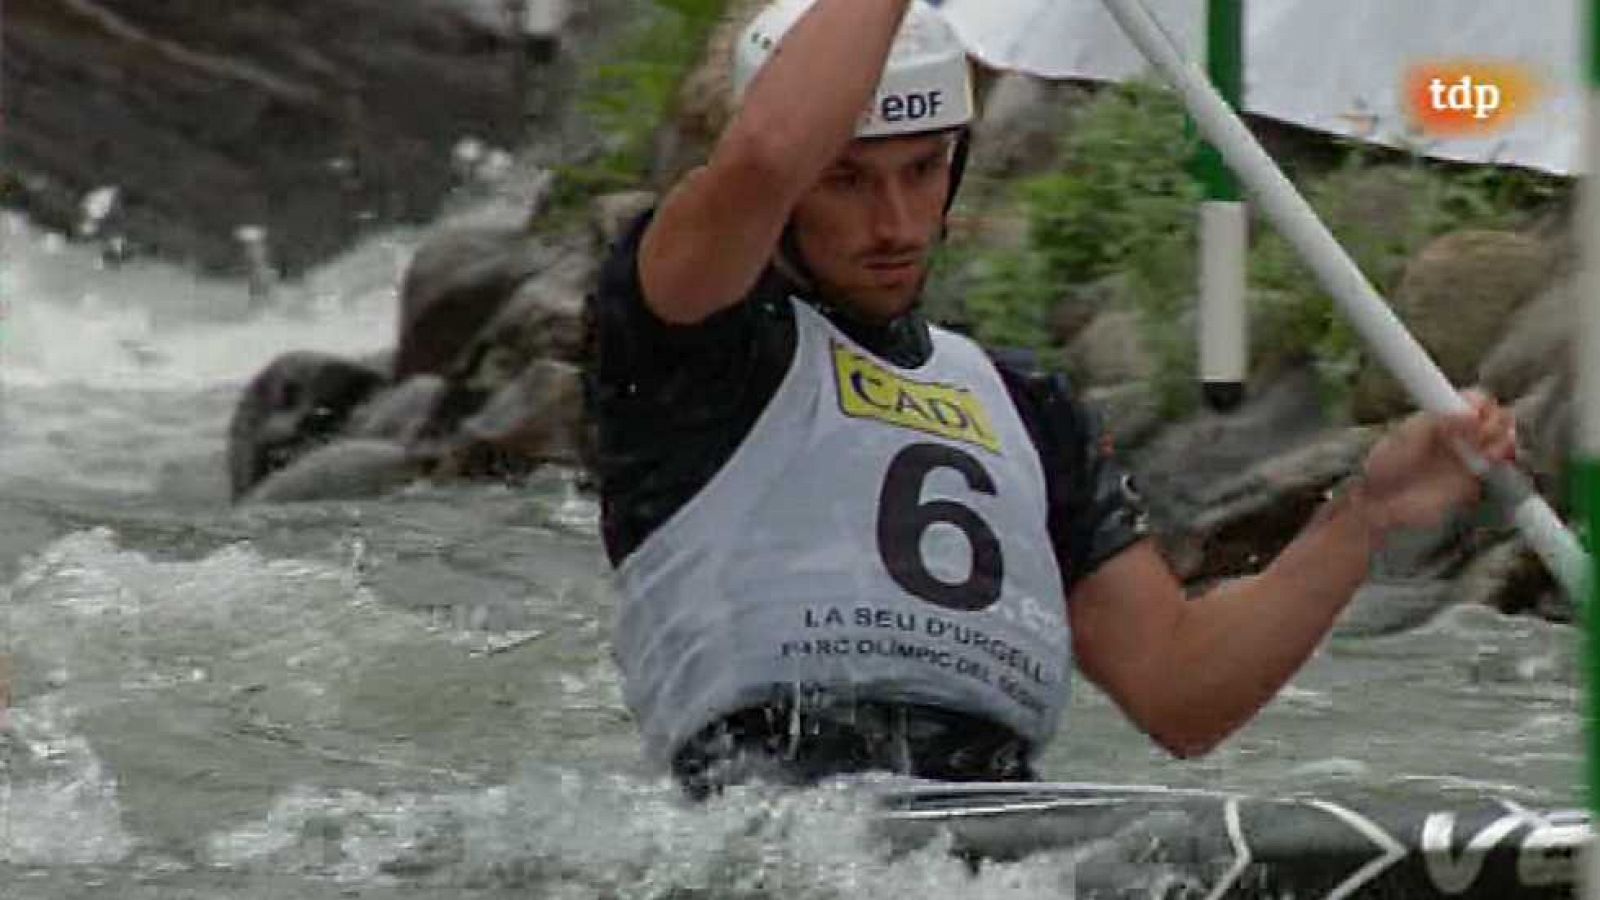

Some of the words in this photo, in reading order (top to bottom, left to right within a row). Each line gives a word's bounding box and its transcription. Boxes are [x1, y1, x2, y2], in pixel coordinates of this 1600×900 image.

[876, 442, 1004, 612] 6
[781, 638, 850, 658] PARC
[804, 606, 844, 629] LA
[853, 606, 916, 633] SEU
[926, 616, 1049, 686] D'URGELL
